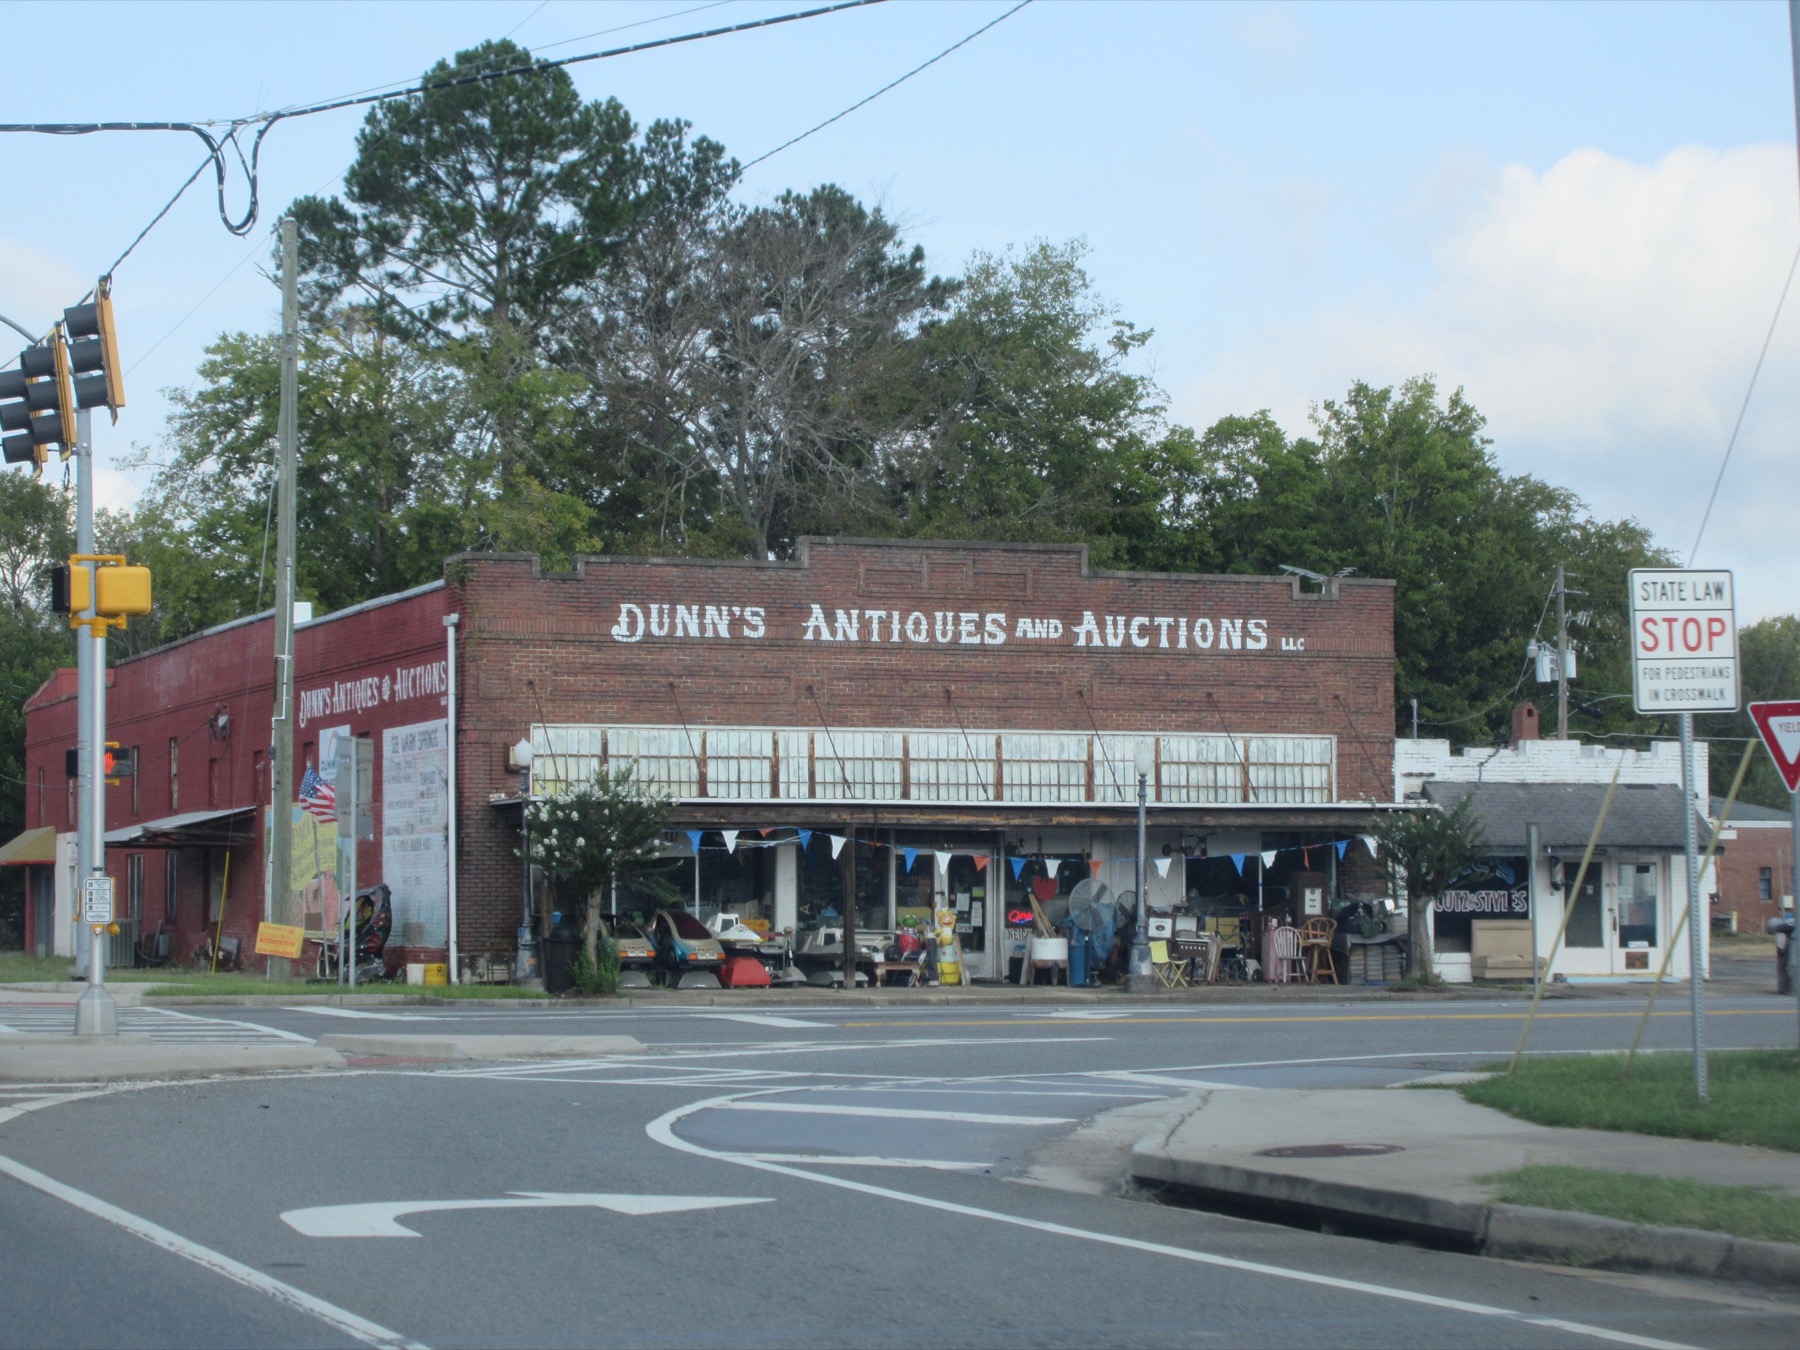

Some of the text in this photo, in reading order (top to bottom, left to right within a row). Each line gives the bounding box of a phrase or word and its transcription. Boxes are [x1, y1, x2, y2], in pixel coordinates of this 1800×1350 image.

[1640, 581, 1725, 601] STATE LAW
[611, 603, 1305, 651] DUNN'S ANTIQUES AND AUCTIONS LLC
[1640, 617, 1726, 652] STOP
[1643, 666, 1731, 680] FOR PEDESTRIANS
[299, 686, 331, 728] DUNN'S
[332, 677, 379, 714] ANTIQUES
[393, 661, 447, 702] AUCTIONS
[1649, 688, 1727, 701] IN CROSSWALK
